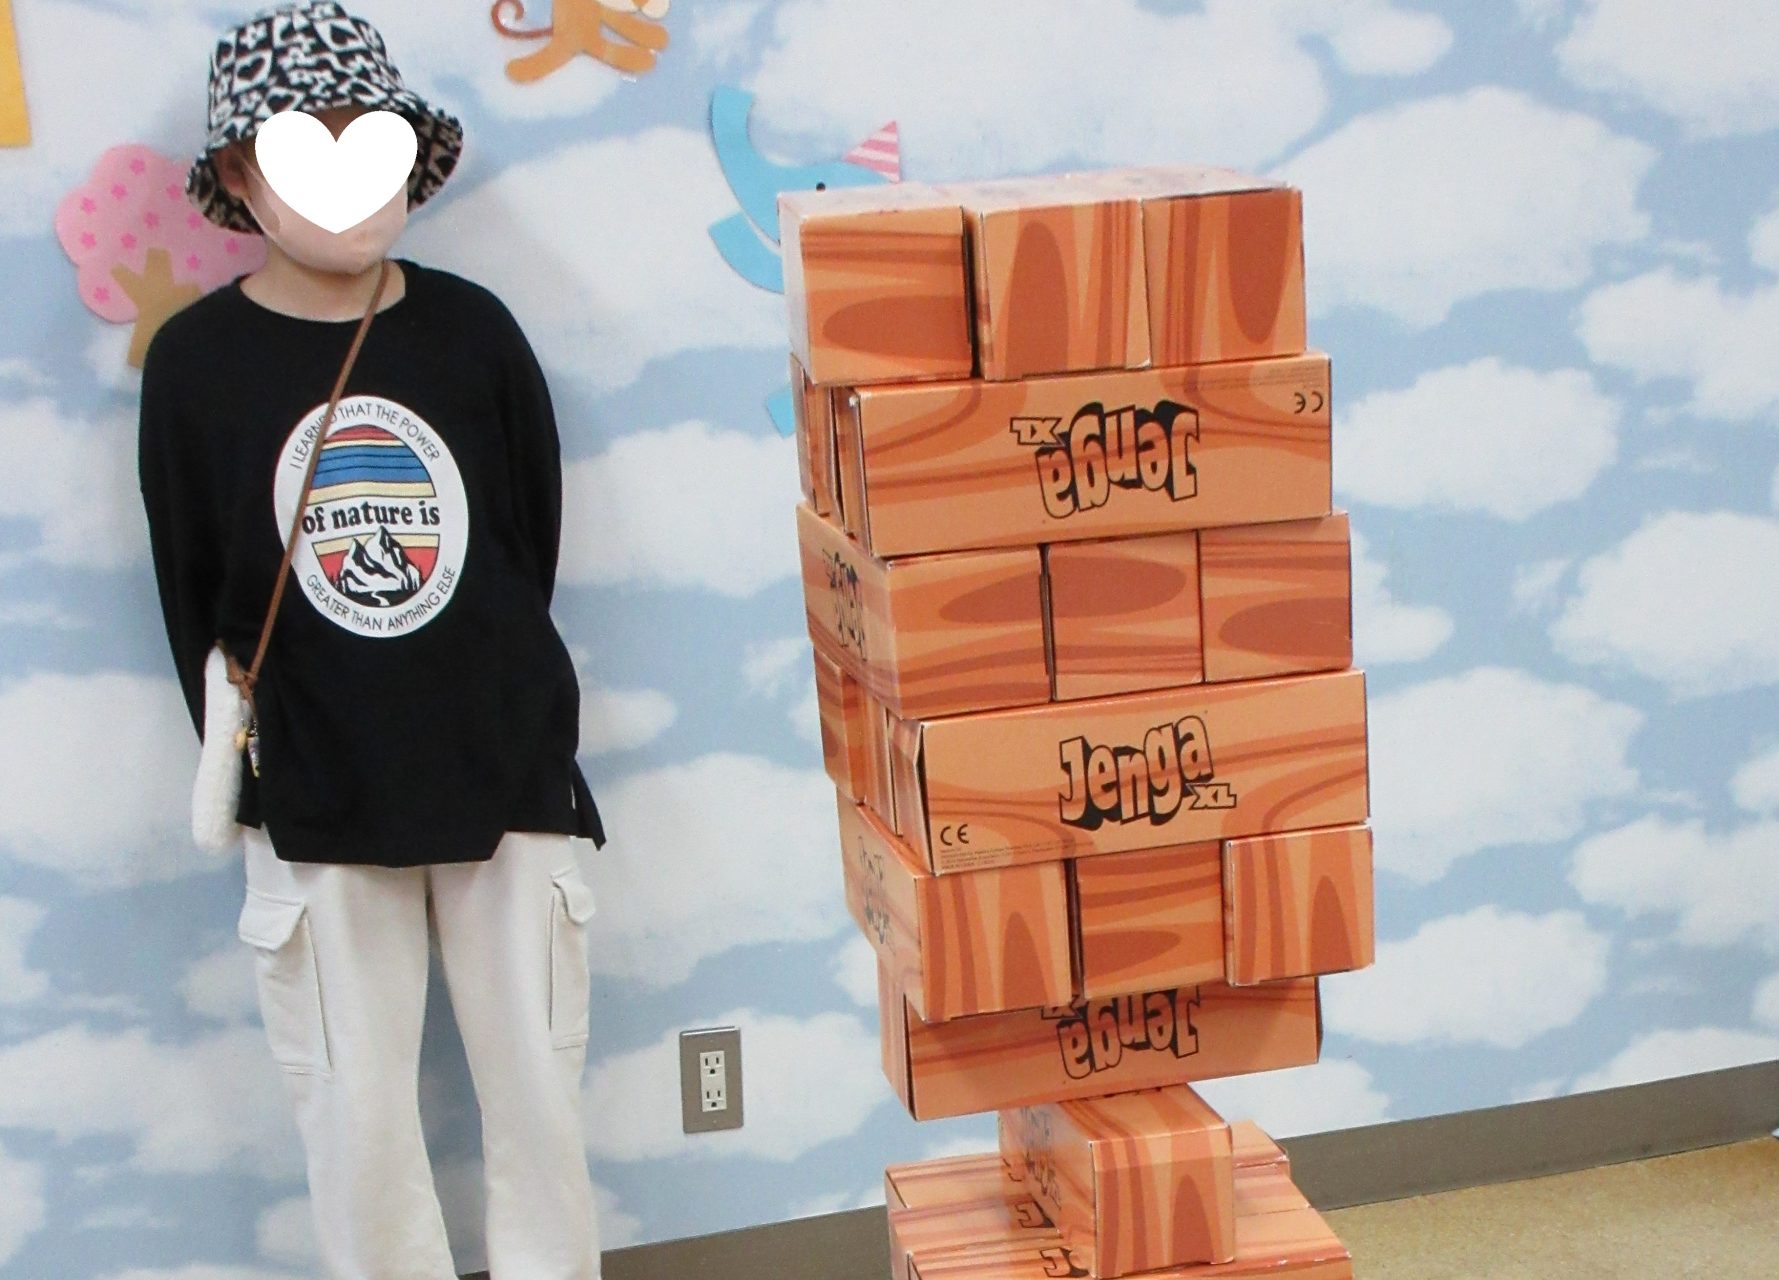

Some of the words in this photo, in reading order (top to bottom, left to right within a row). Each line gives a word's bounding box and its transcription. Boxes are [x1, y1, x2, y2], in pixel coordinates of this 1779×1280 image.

[338, 403, 372, 420] THAT
[376, 405, 400, 425] THE
[400, 417, 440, 461] POWER
[1010, 416, 1067, 447] XL
[1035, 399, 1200, 519] Jenga
[302, 506, 326, 534] of
[331, 501, 413, 529] nature
[418, 500, 440, 526] is
[307, 574, 350, 619] GREATER
[352, 610, 382, 630] THAN
[388, 592, 440, 630] ANYTHING
[437, 565, 455, 594] ELSE
[1058, 714, 1215, 832] Jenga
[1185, 782, 1238, 810] XL
